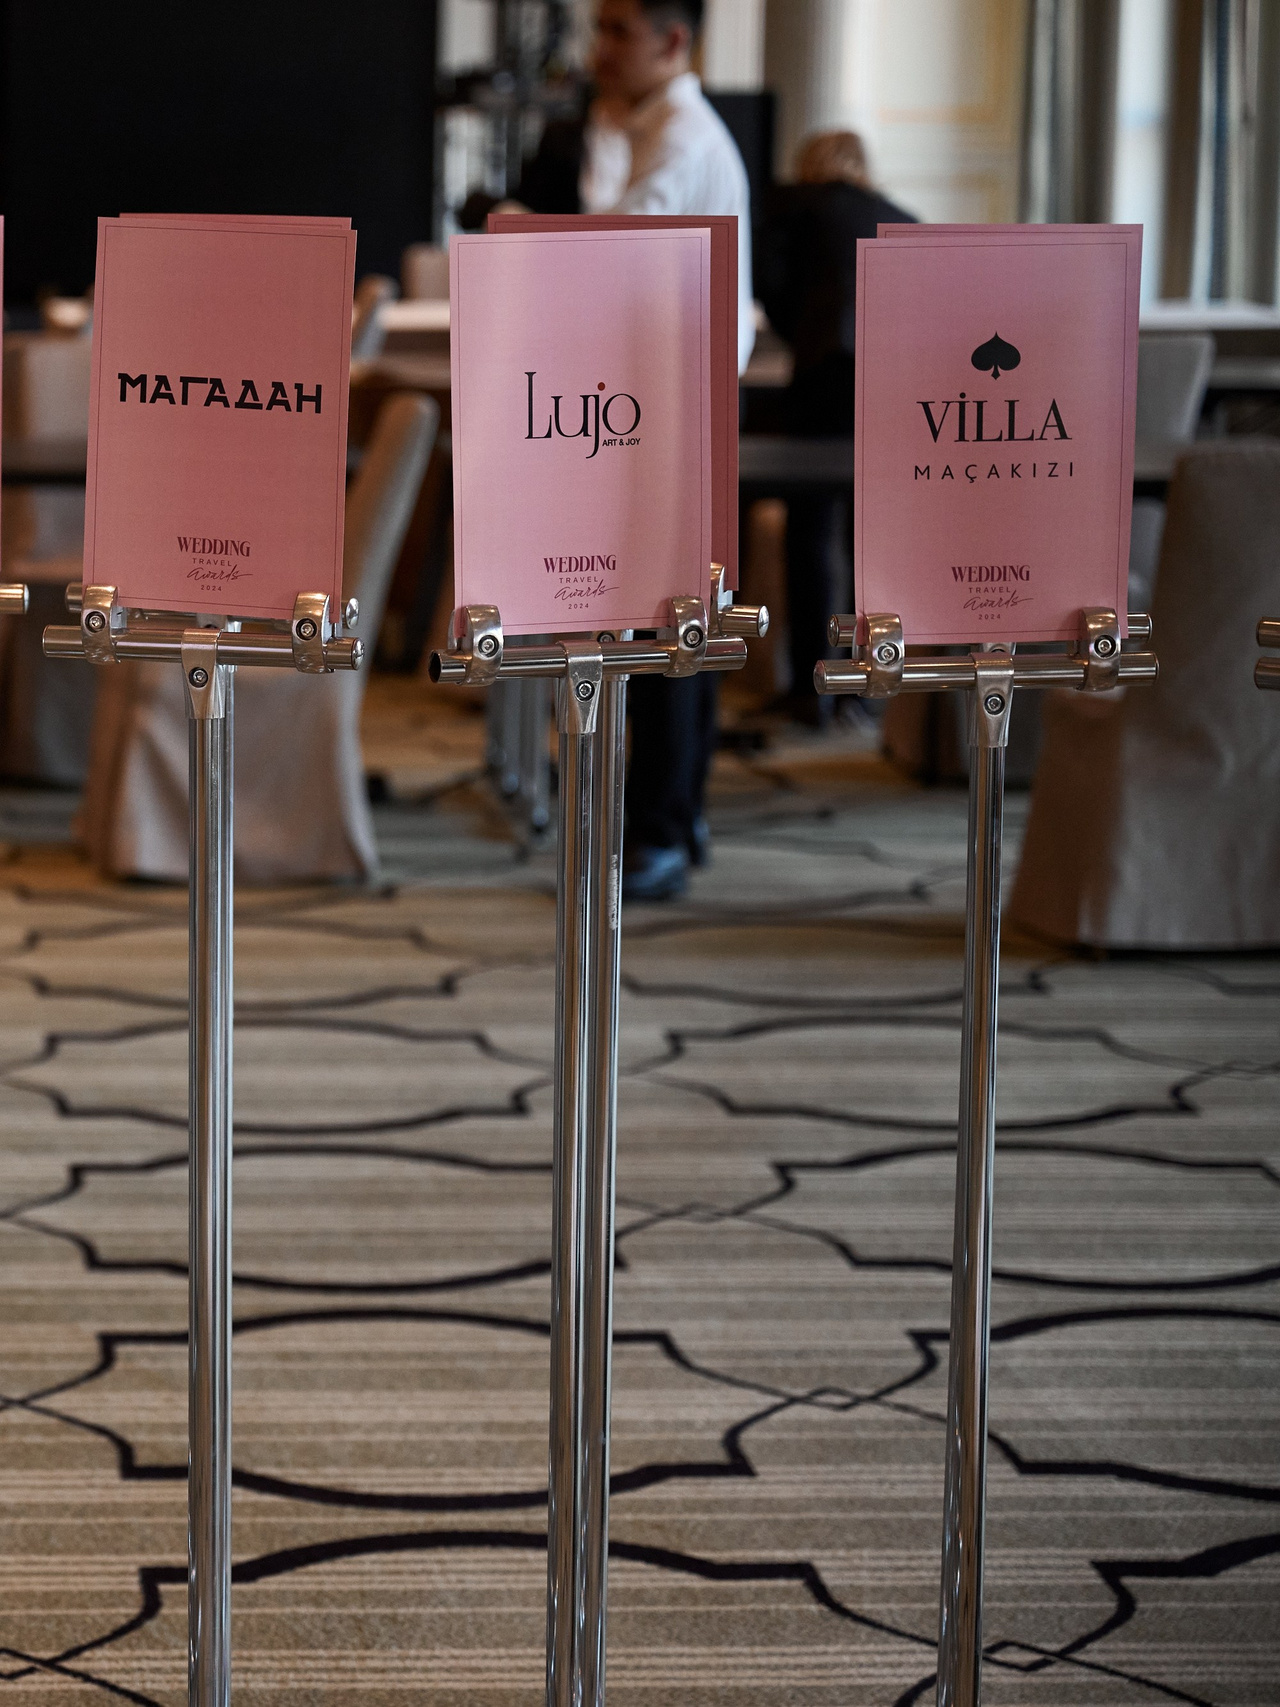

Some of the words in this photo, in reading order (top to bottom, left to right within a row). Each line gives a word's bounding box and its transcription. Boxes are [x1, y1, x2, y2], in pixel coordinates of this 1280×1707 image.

[117, 372, 322, 414] МАГАДАН
[524, 371, 641, 459] Lujo
[602, 438, 618, 447] ART
[618, 437, 625, 446] &
[625, 437, 641, 446] JOY
[914, 461, 1074, 484] MAÇAKIZI
[177, 536, 251, 558] WEDDING
[192, 557, 232, 567] TRAVEL
[543, 554, 617, 574] WEDDING
[186, 563, 254, 582] awards
[559, 576, 599, 584] TRAVEL
[951, 564, 1031, 583] WEDDING
[200, 584, 222, 592] 2024
[553, 578, 621, 601] awards
[968, 586, 1011, 594] TRAVEL
[567, 602, 590, 610] 2024
[963, 589, 1035, 611] awards
[978, 613, 1001, 621] 2024
